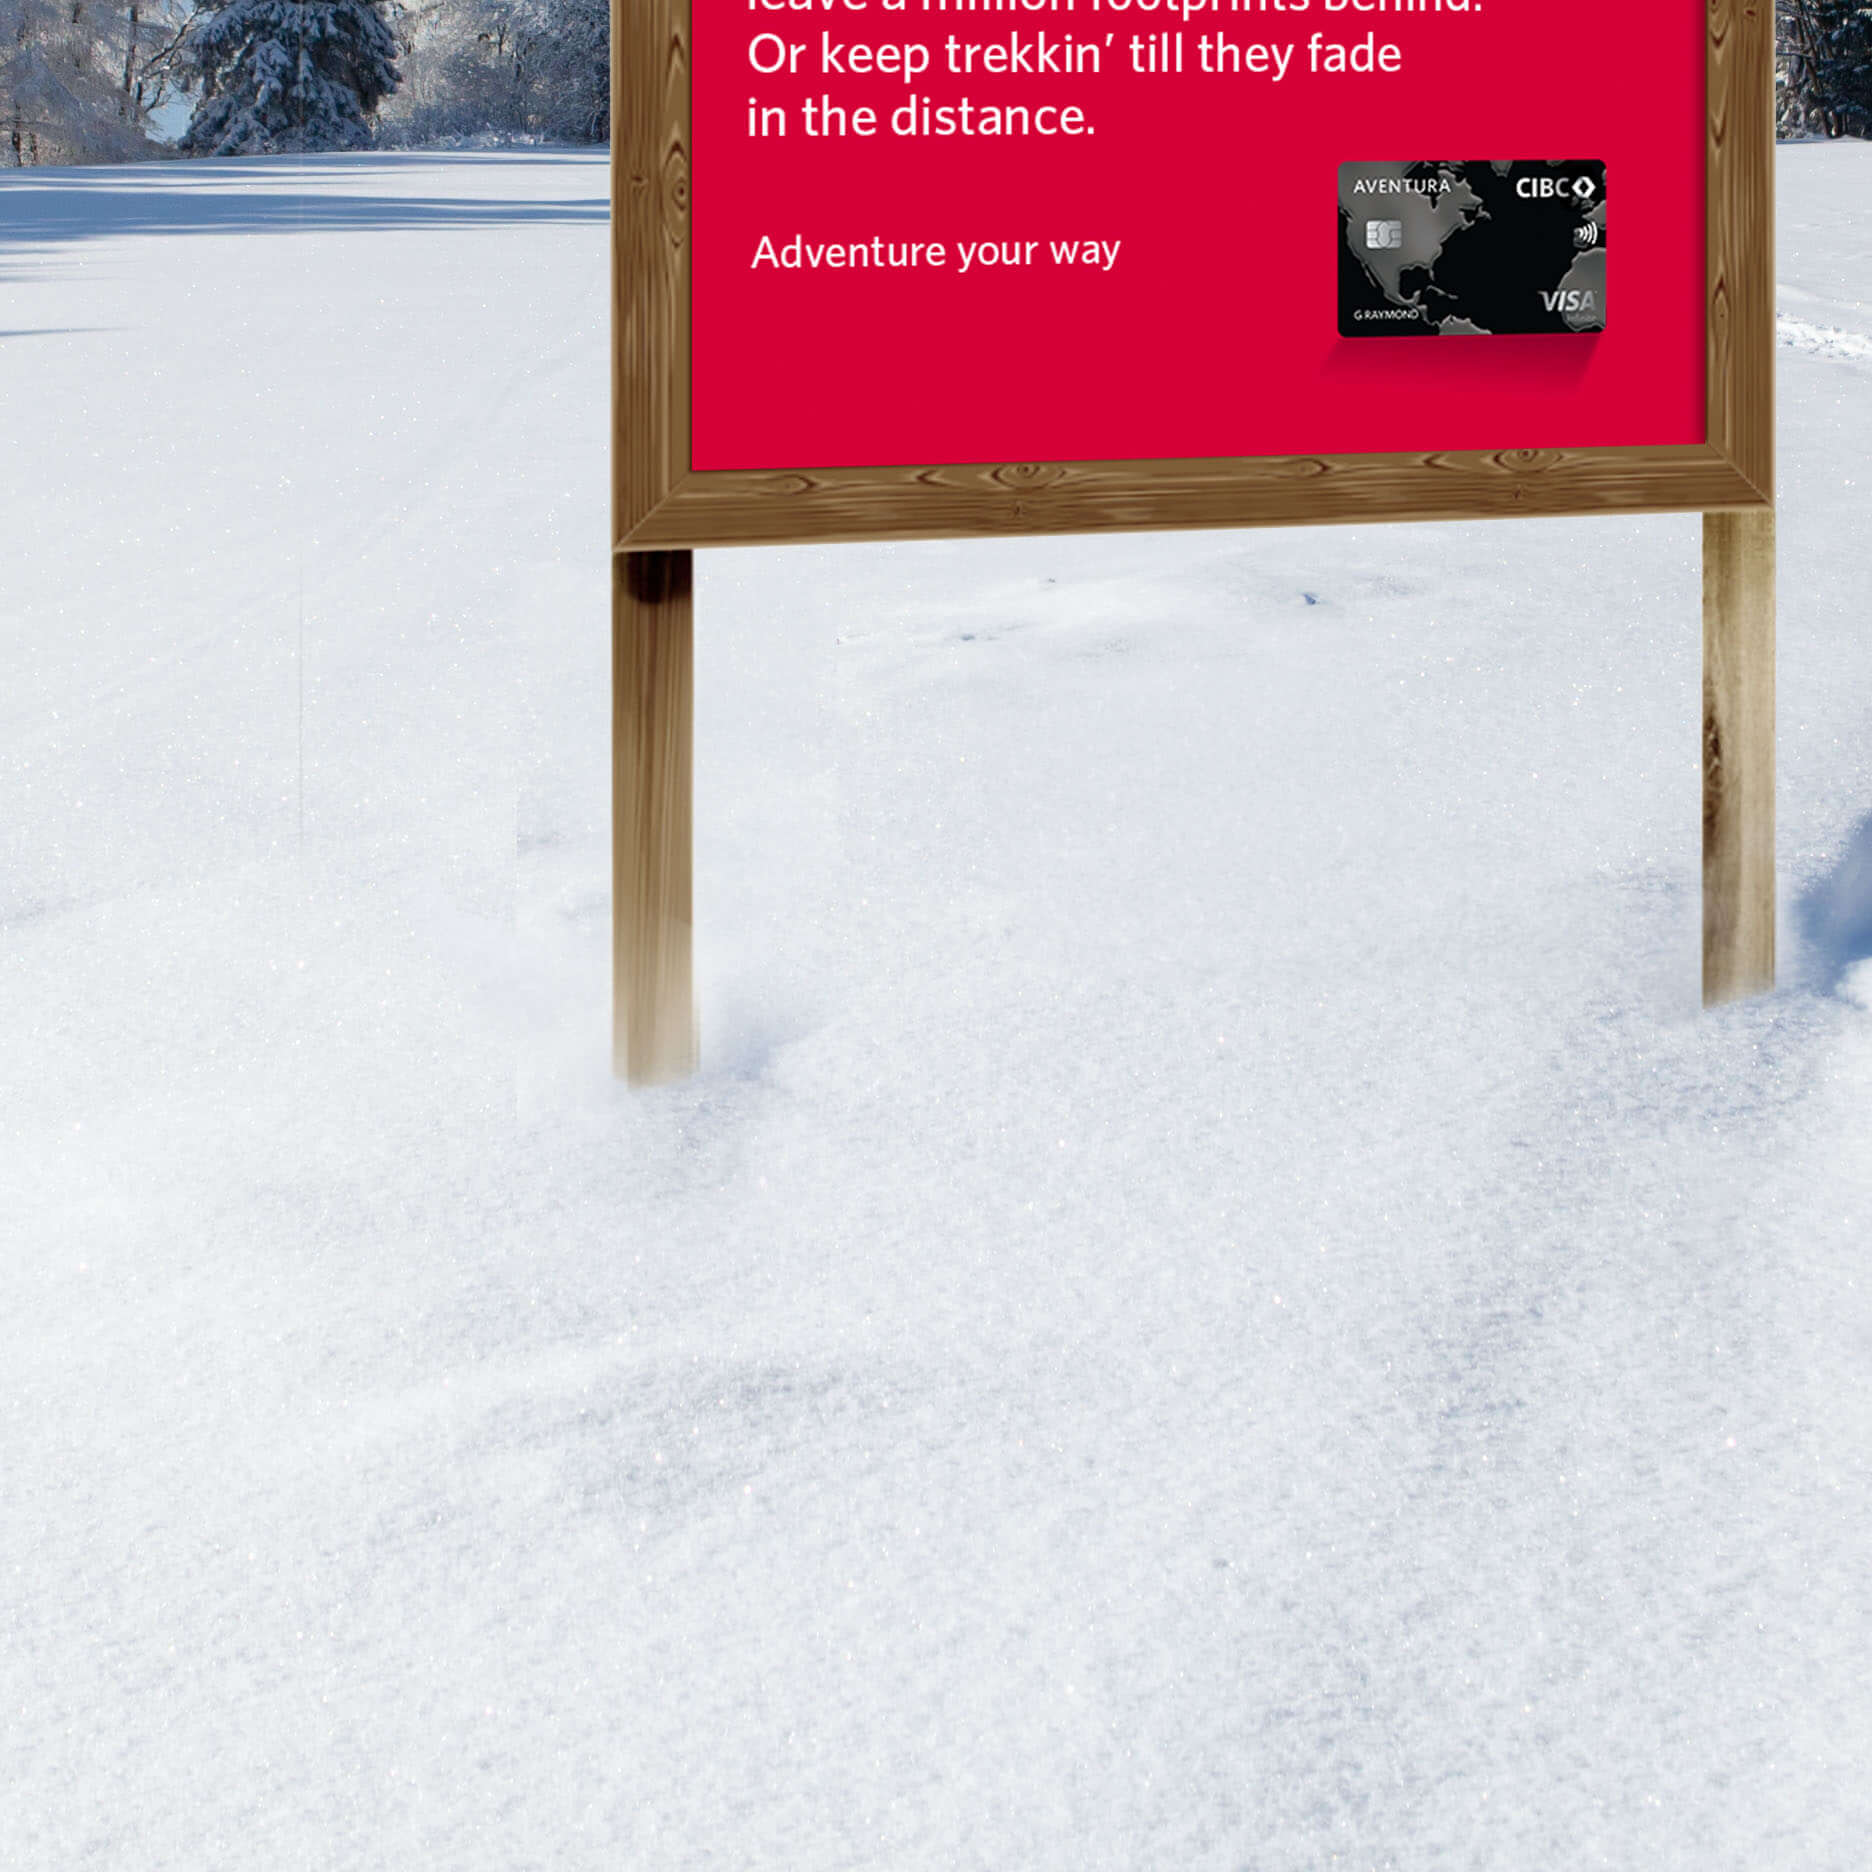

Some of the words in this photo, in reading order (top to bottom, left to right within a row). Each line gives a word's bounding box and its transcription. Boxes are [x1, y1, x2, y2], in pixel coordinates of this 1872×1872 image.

[748, 32, 807, 74] Or
[821, 30, 930, 82] keep
[944, 30, 1115, 73] trekkin’
[1128, 31, 1183, 73] till
[1197, 31, 1295, 82] they
[1307, 31, 1402, 73] fade
[748, 96, 786, 137] in
[801, 93, 877, 137] the
[891, 93, 1095, 136] distance.
[1353, 177, 1452, 195] AVENTURA
[1515, 177, 1570, 199] CIBC
[750, 233, 946, 269] Adventure
[956, 241, 1039, 274] your
[1049, 240, 1121, 272] way
[1537, 290, 1595, 312] VISA
